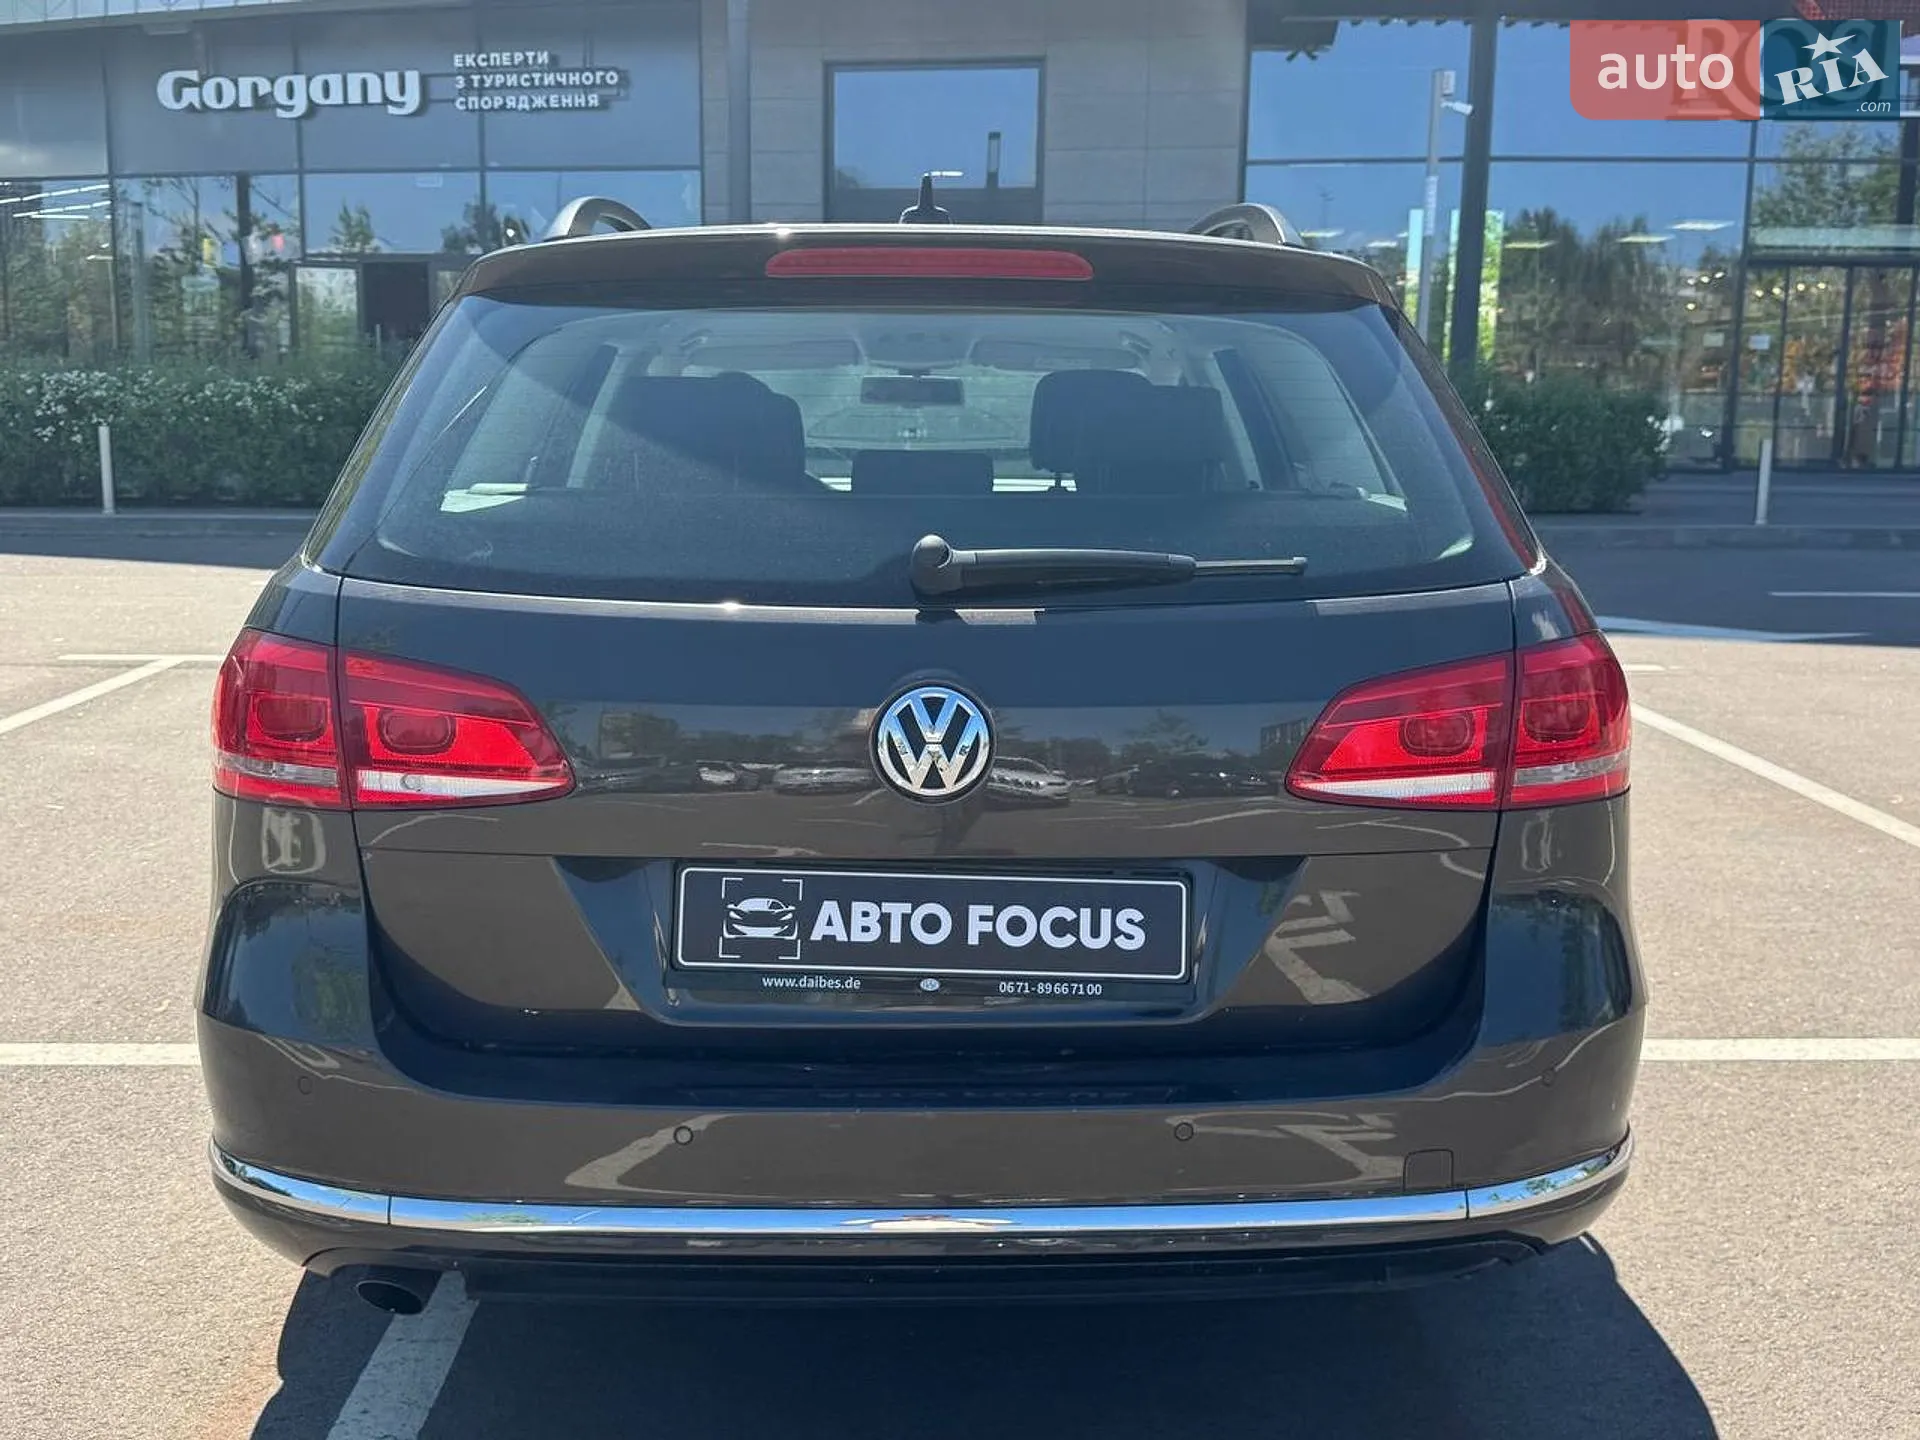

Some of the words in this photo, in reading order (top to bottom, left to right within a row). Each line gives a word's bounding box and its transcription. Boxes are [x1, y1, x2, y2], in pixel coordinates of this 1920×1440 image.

[453, 50, 549, 68] ЕКСПЕРТИ
[470, 71, 619, 88] ТУРИСТИЧНОГО
[156, 69, 420, 119] Gorgany
[455, 93, 600, 111] СПОРЯДЖЕННЯ
[966, 904, 1146, 950] FOCUS
[998, 981, 1103, 996] 0671-89667100
